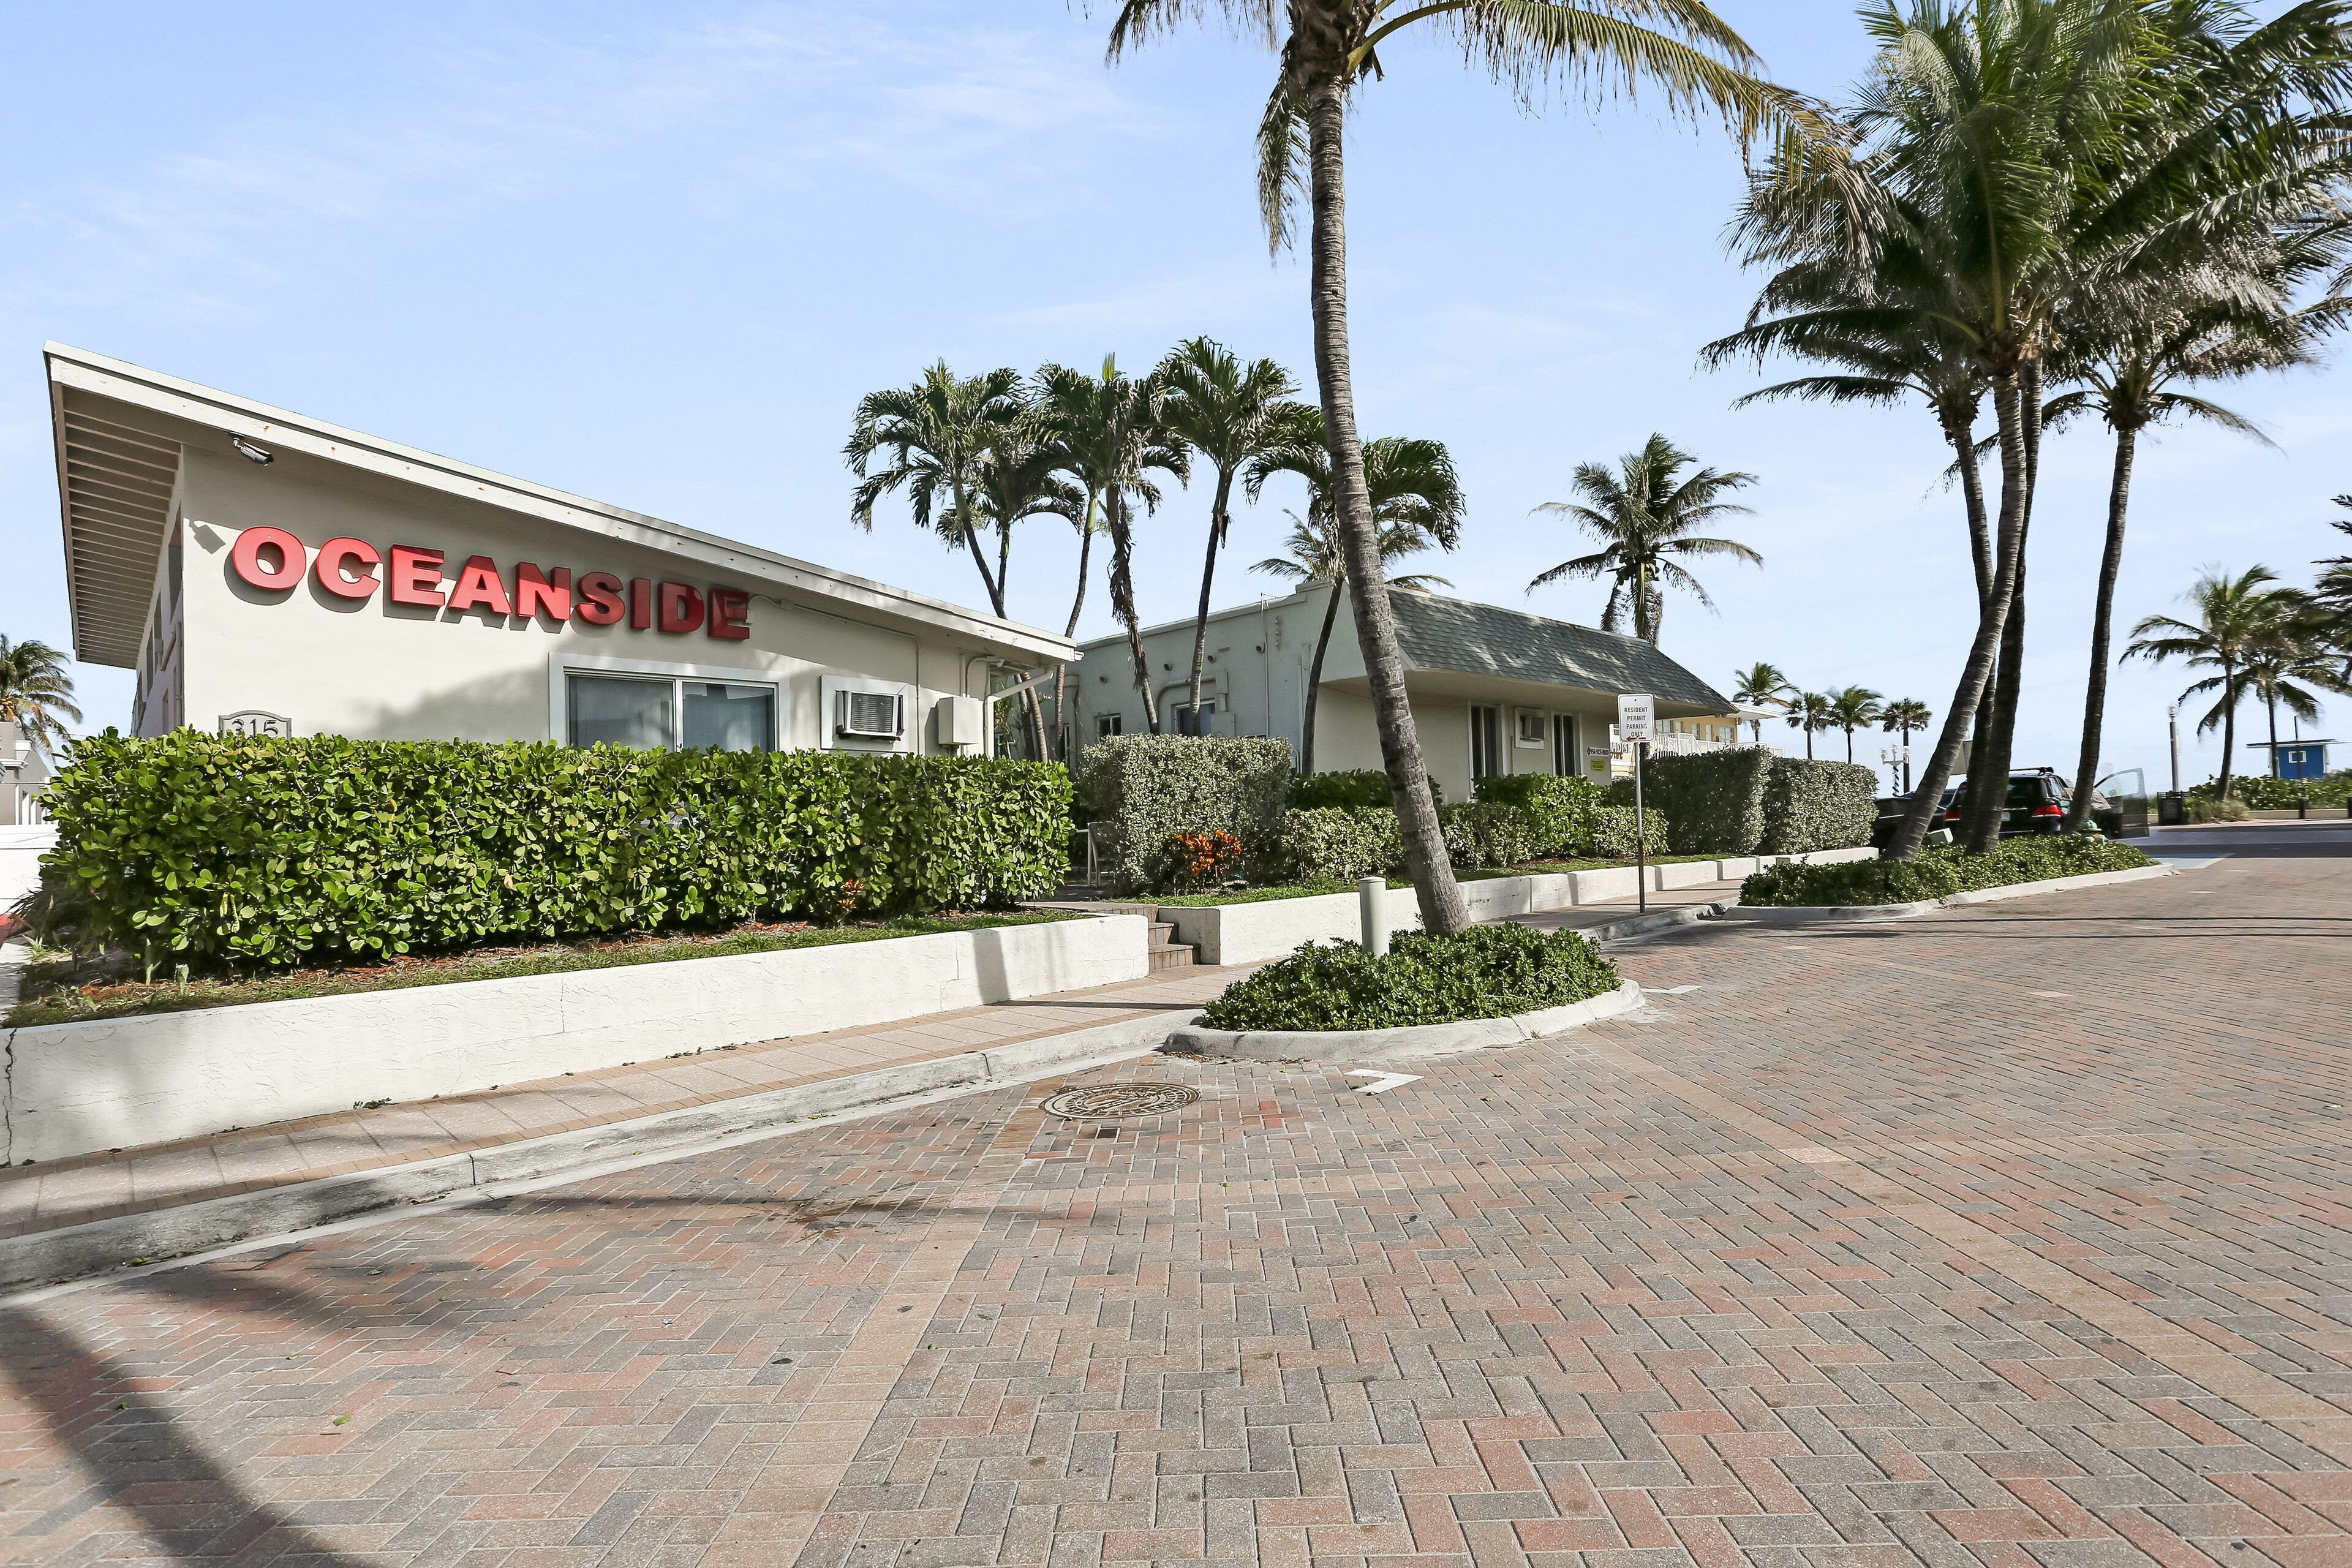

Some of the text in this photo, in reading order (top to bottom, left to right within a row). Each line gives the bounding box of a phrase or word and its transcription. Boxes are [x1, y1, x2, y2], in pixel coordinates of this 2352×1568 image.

[232, 526, 750, 641] OCEANSIDE
[232, 718, 279, 739] 315
[1610, 742, 1631, 753] ADISE
